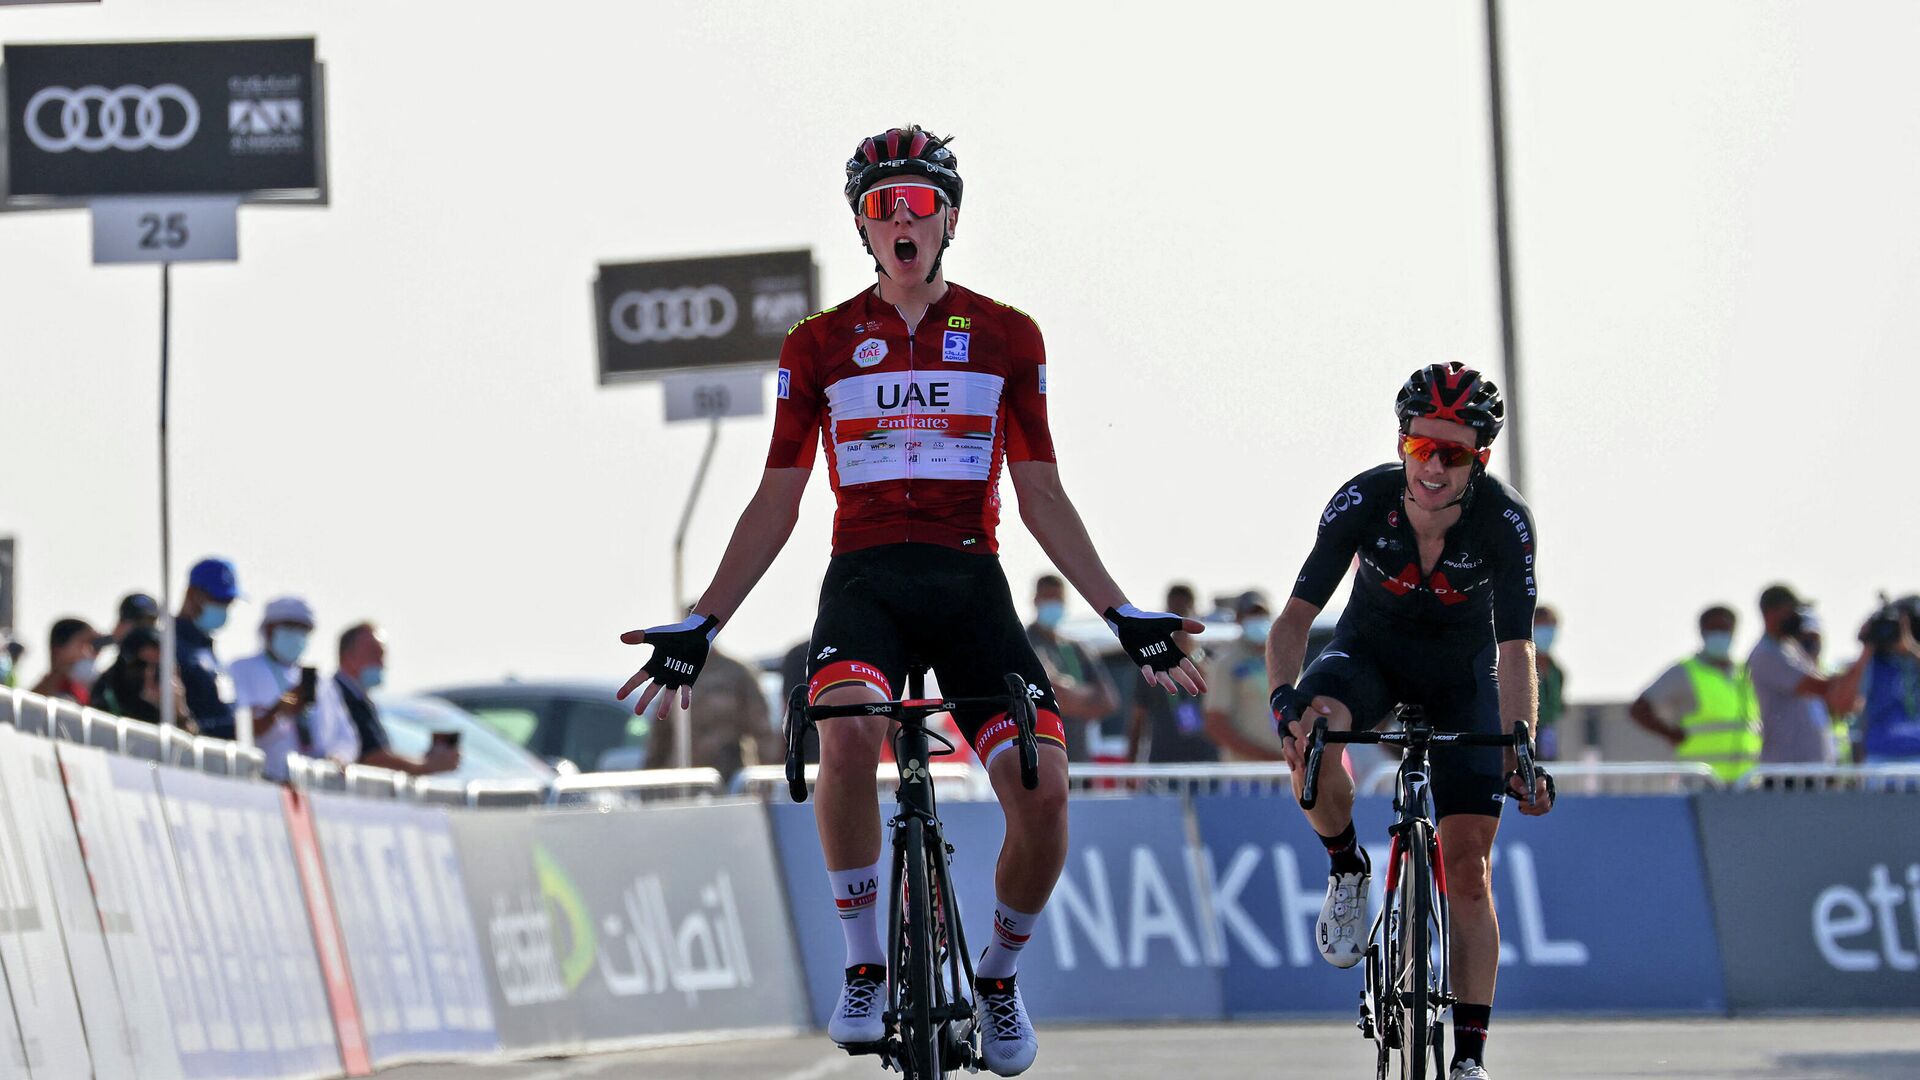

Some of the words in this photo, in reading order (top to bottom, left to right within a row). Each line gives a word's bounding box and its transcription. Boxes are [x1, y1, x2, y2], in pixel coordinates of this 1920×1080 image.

[880, 159, 907, 168] MET
[138, 211, 189, 250] 25
[859, 349, 881, 359] UAE
[877, 382, 950, 410] UAE
[877, 418, 950, 430] Emirates
[1139, 640, 1168, 658] GOBIK
[664, 656, 694, 675] GOBIK
[1432, 734, 1459, 742] MOST
[847, 875, 879, 896] UA
[994, 909, 1017, 930] AE
